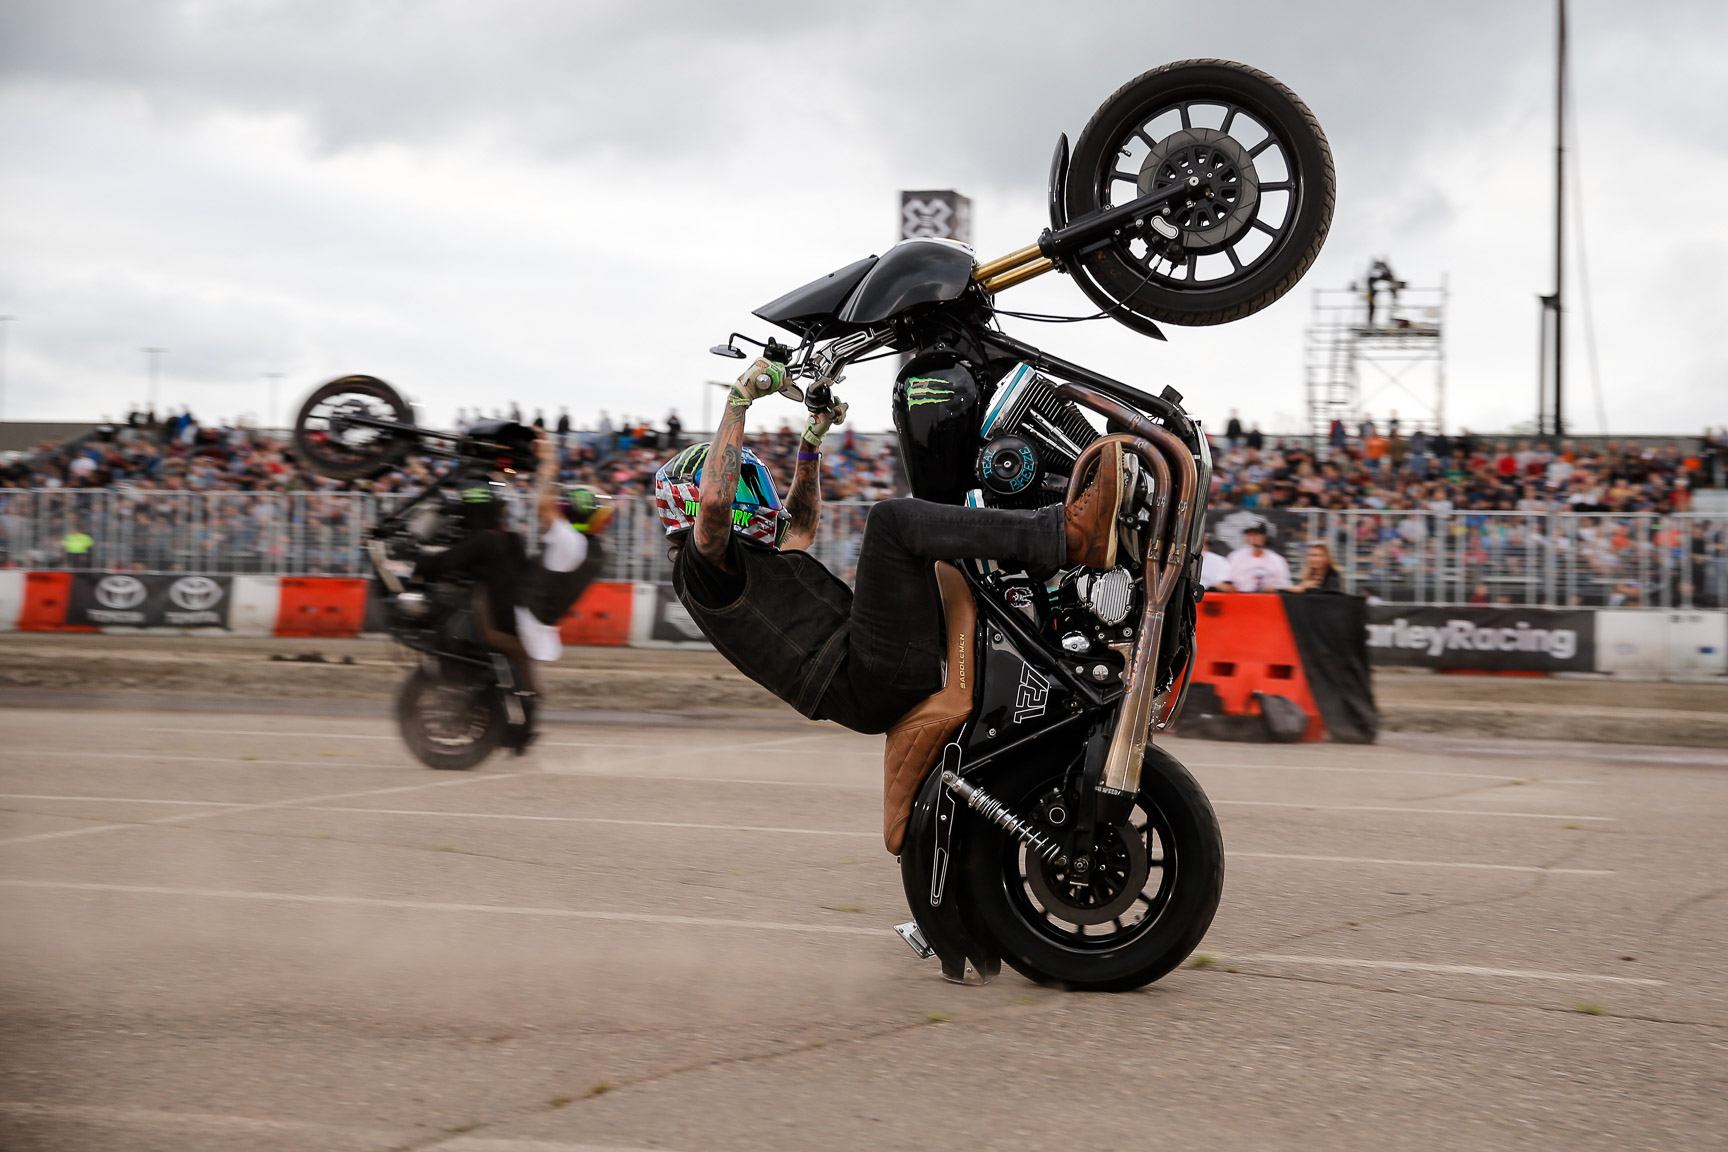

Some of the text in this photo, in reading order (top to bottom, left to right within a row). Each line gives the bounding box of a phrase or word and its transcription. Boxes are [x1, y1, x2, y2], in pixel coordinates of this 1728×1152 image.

[982, 446, 1035, 492] TEAL BREEZE
[1365, 617, 1578, 659] arleyRacing
[1013, 660, 1051, 724] 127
